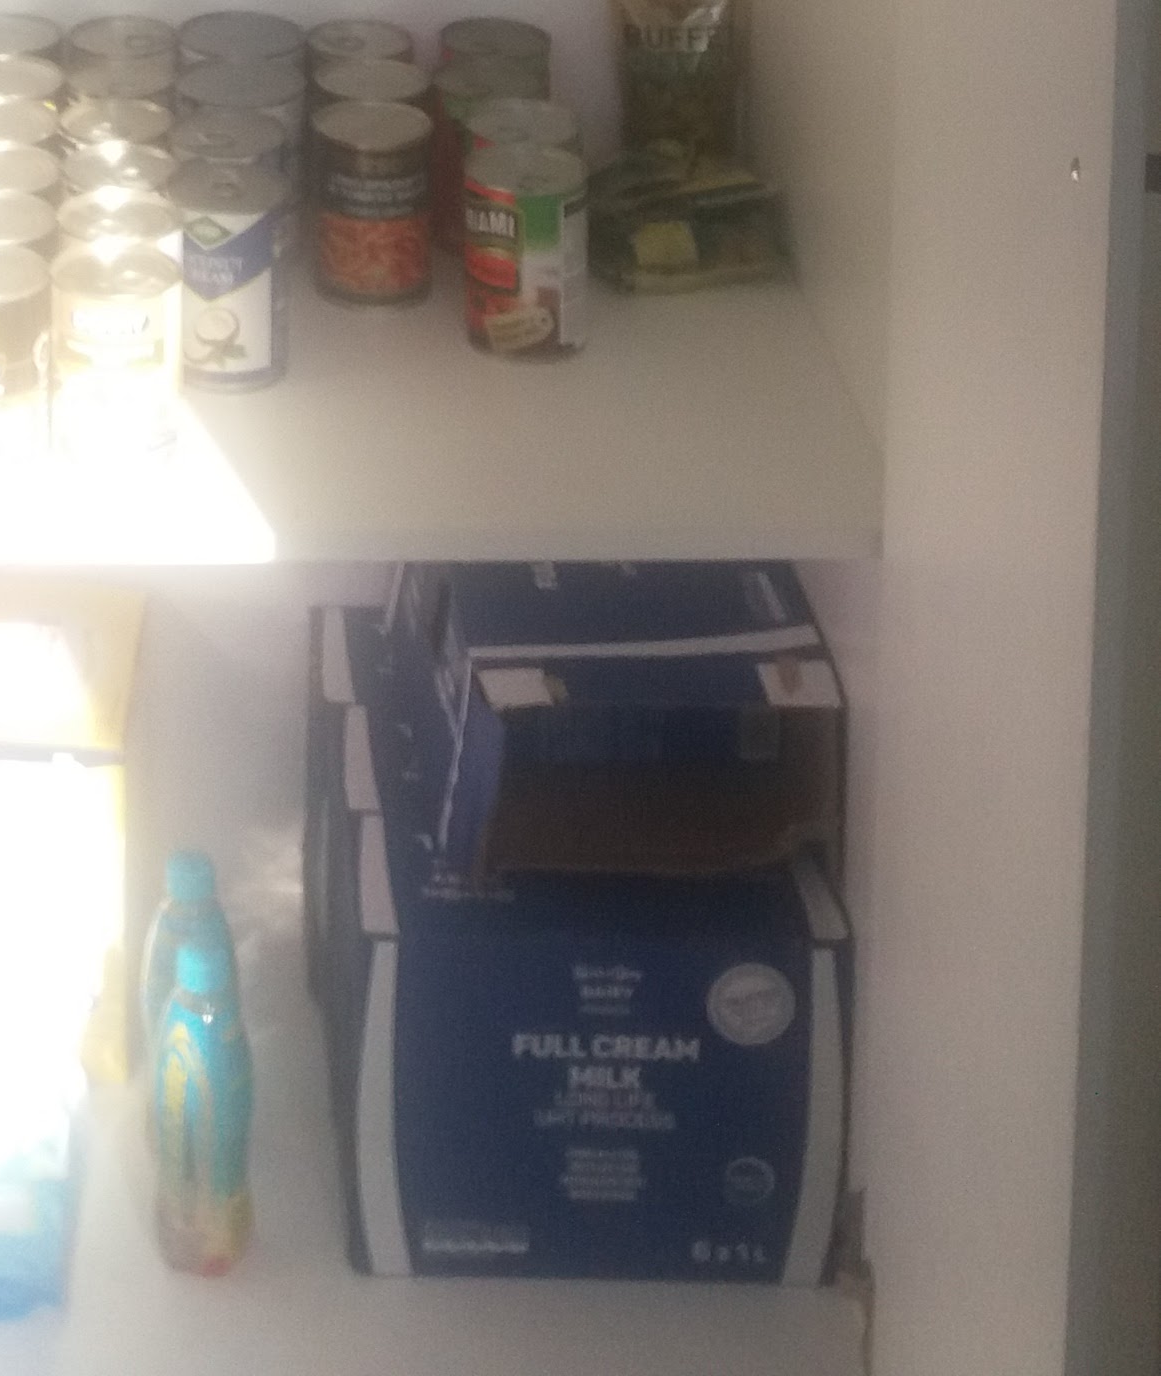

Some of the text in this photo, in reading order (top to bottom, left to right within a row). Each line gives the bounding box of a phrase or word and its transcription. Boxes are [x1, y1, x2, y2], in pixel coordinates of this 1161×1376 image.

[512, 1032, 701, 1062] FULL CREAM
[568, 1065, 642, 1090] MILK
